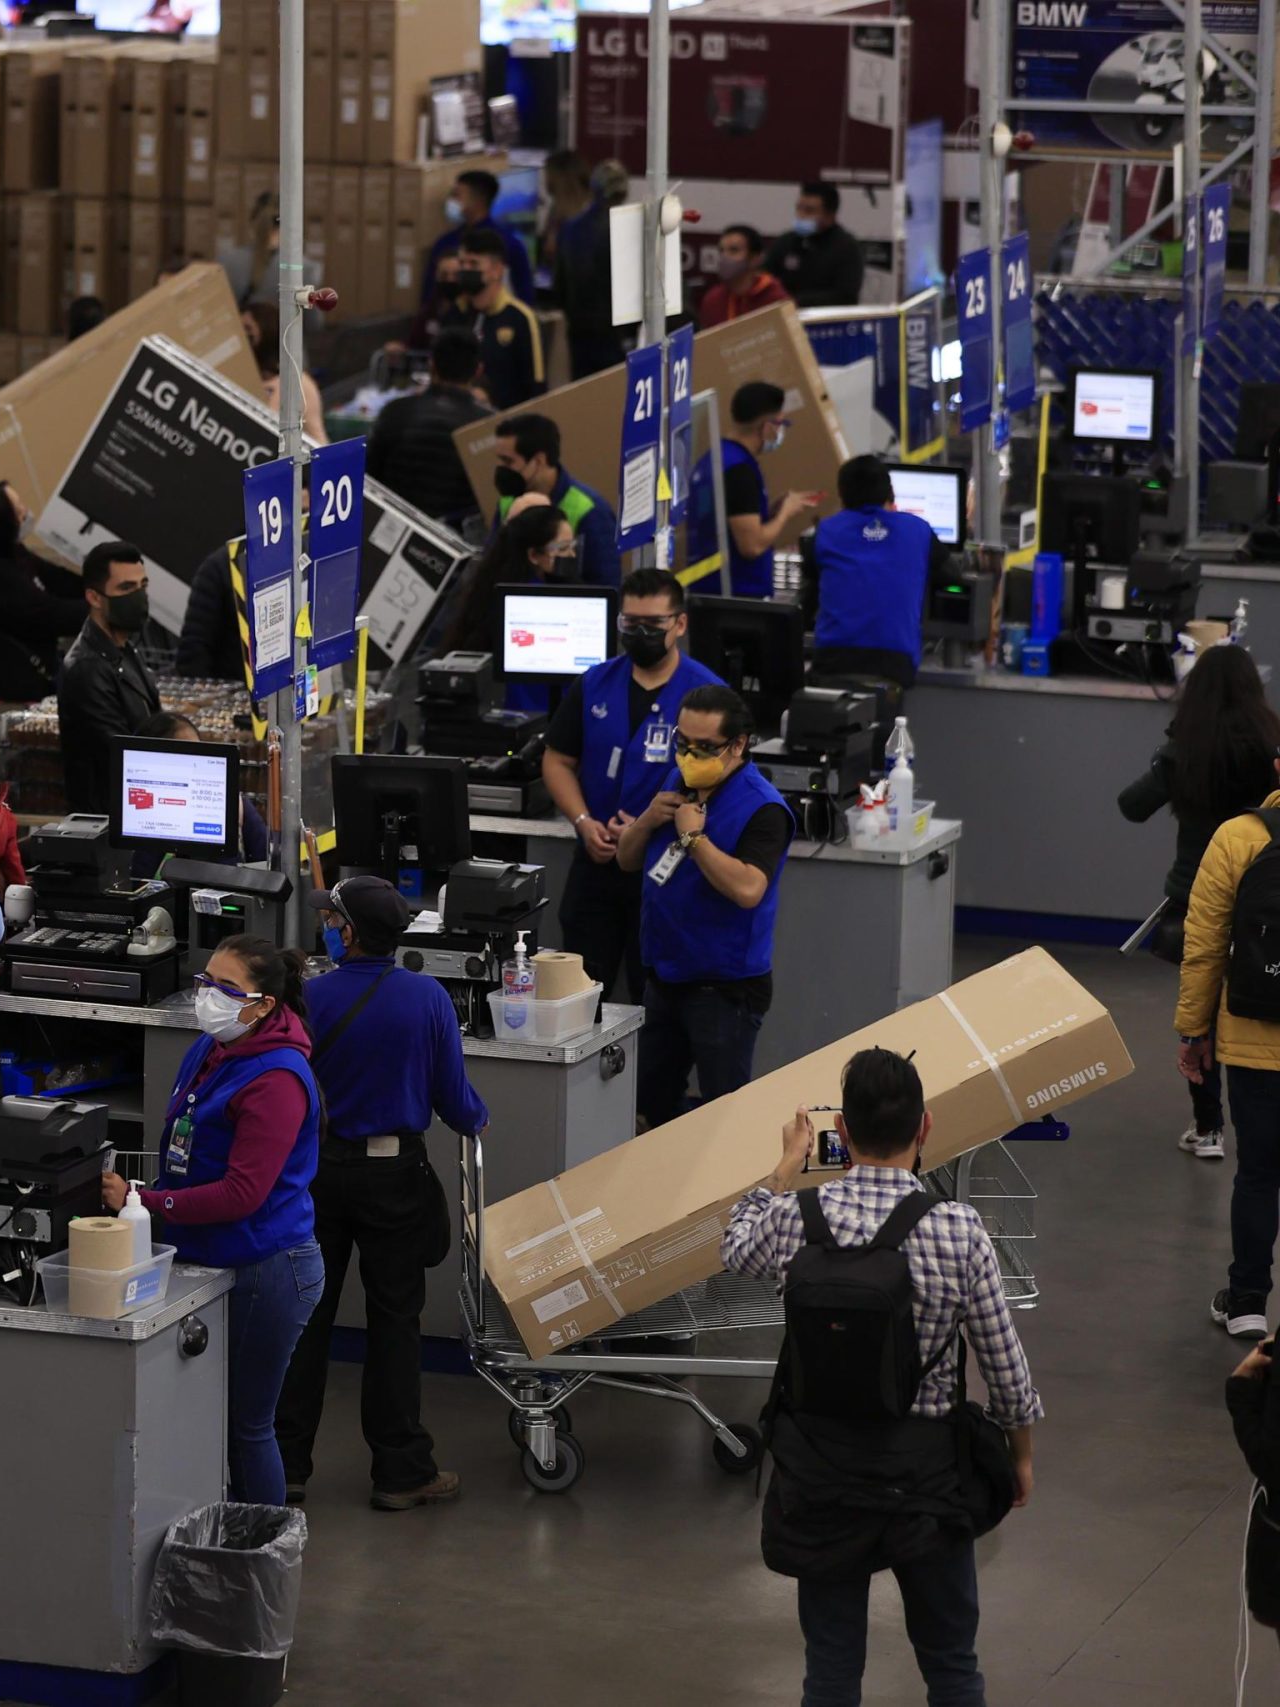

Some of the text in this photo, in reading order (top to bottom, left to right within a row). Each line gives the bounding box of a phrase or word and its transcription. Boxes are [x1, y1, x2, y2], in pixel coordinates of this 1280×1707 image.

[1017, 2, 1088, 27] BMW
[588, 28, 628, 57] LG
[635, 31, 697, 59] UD
[1208, 206, 1224, 243] 26
[965, 276, 985, 318] 23
[1008, 259, 1025, 300] 24
[907, 318, 928, 390] BMW
[634, 376, 652, 422] 21
[673, 357, 688, 402] 22
[136, 367, 180, 411] LG
[179, 397, 273, 469] NanoC
[258, 496, 282, 547] 19
[321, 475, 352, 527] 20
[387, 568, 424, 609] 55
[1026, 1061, 1108, 1108] SAMSUNG
[556, 1234, 617, 1266] Crytal
